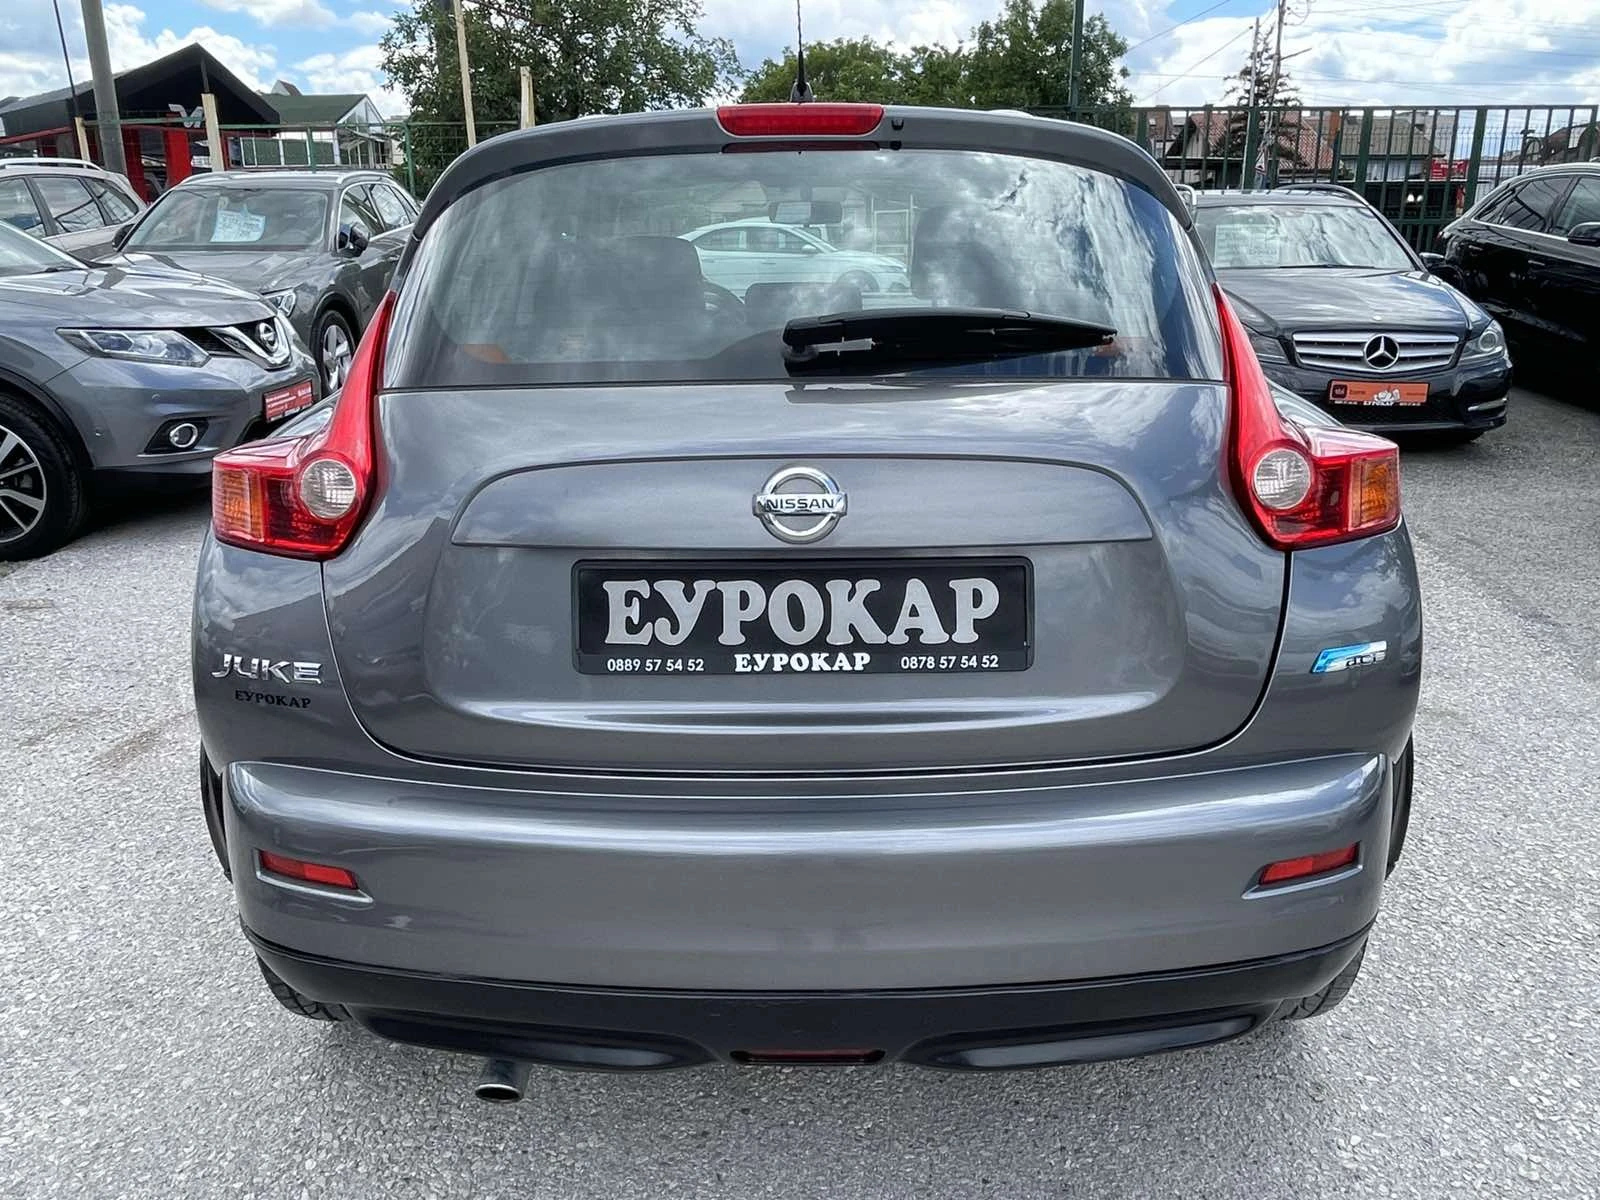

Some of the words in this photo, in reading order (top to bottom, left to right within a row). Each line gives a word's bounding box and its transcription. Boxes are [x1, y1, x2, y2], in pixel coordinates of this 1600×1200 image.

[766, 498, 834, 509] NISSAN
[603, 578, 1000, 646] ЕУРОКАР
[211, 653, 322, 684] JUKE
[606, 658, 641, 673] 0889
[644, 658, 662, 673] 57
[665, 658, 683, 673] 54
[686, 658, 705, 673] 52
[734, 652, 871, 673] ЕУРОКАР
[900, 655, 936, 670] 0878
[938, 655, 957, 670] 57
[960, 655, 978, 669] 54
[980, 654, 999, 669] 52
[234, 689, 312, 709] ЕУРОКАР
